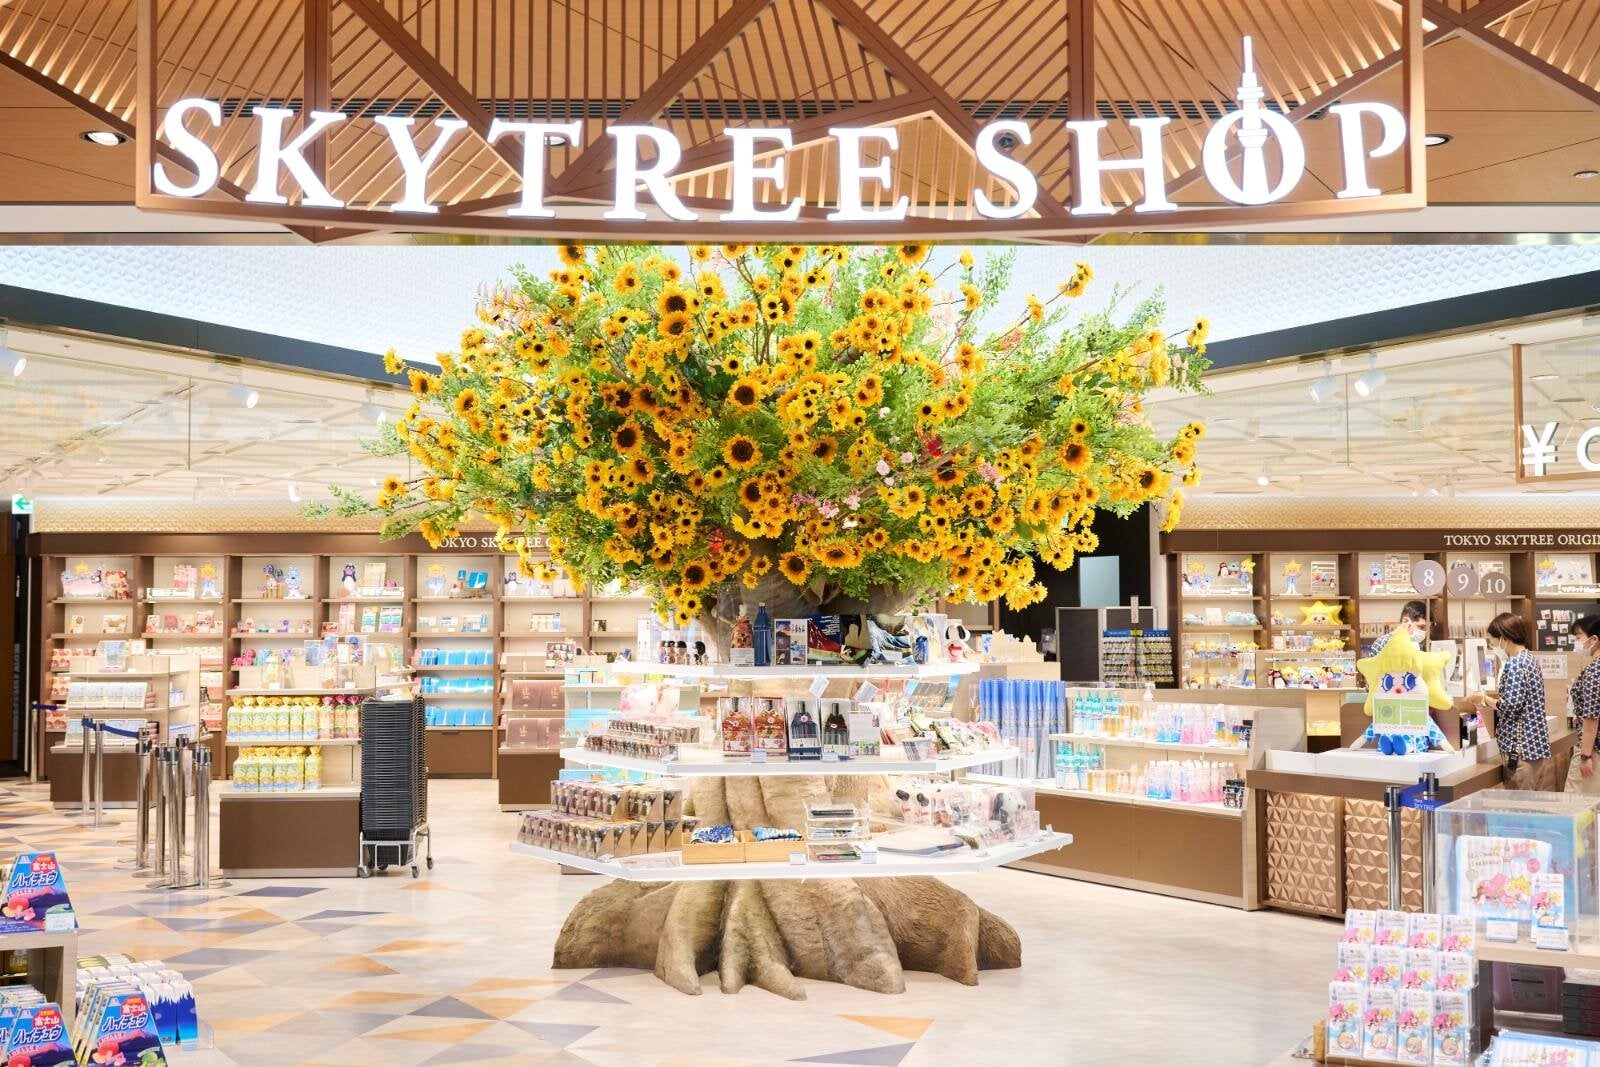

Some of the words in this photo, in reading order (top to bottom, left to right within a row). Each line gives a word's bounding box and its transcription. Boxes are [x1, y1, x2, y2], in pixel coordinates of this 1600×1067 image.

[152, 97, 909, 222] SKYTREE
[974, 101, 1407, 219] SHOP
[440, 537, 477, 548] OKYO
[1443, 535, 1491, 546] TOKYO
[1494, 534, 1554, 546] SKYTREE
[1423, 569, 1434, 587] 8
[1458, 573, 1469, 591] 9
[1486, 578, 1506, 593] 10
[32, 861, 56, 871] 富士山
[13, 870, 58, 888] ハイチュウ
[121, 1003, 146, 1014] 富士山
[34, 1016, 60, 1026] 富士山
[102, 1013, 149, 1032] ハイチュウ
[13, 1026, 63, 1045] ハイチュウ
